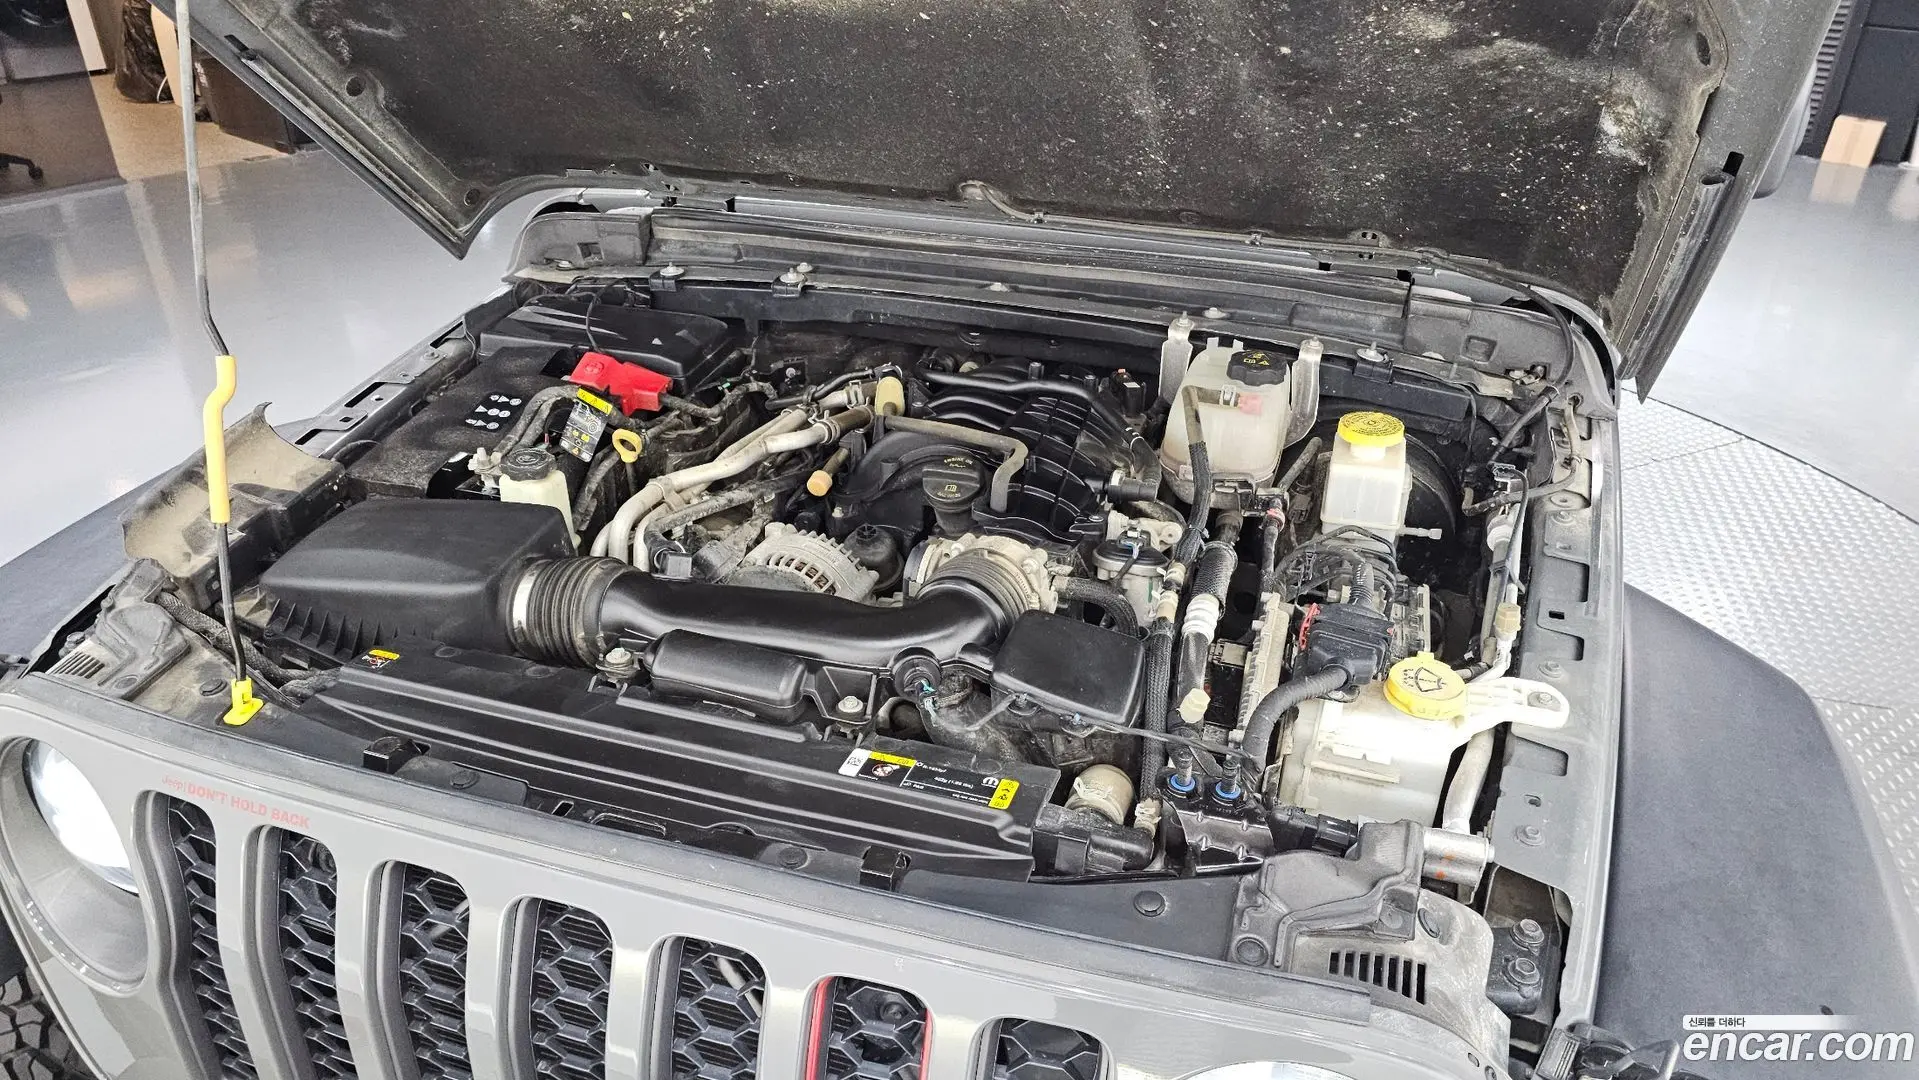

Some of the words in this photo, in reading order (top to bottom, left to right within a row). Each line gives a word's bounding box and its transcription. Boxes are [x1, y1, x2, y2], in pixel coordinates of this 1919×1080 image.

[187, 784, 228, 804] DON'T
[231, 796, 268, 816] HOLD
[271, 808, 311, 829] BACK
